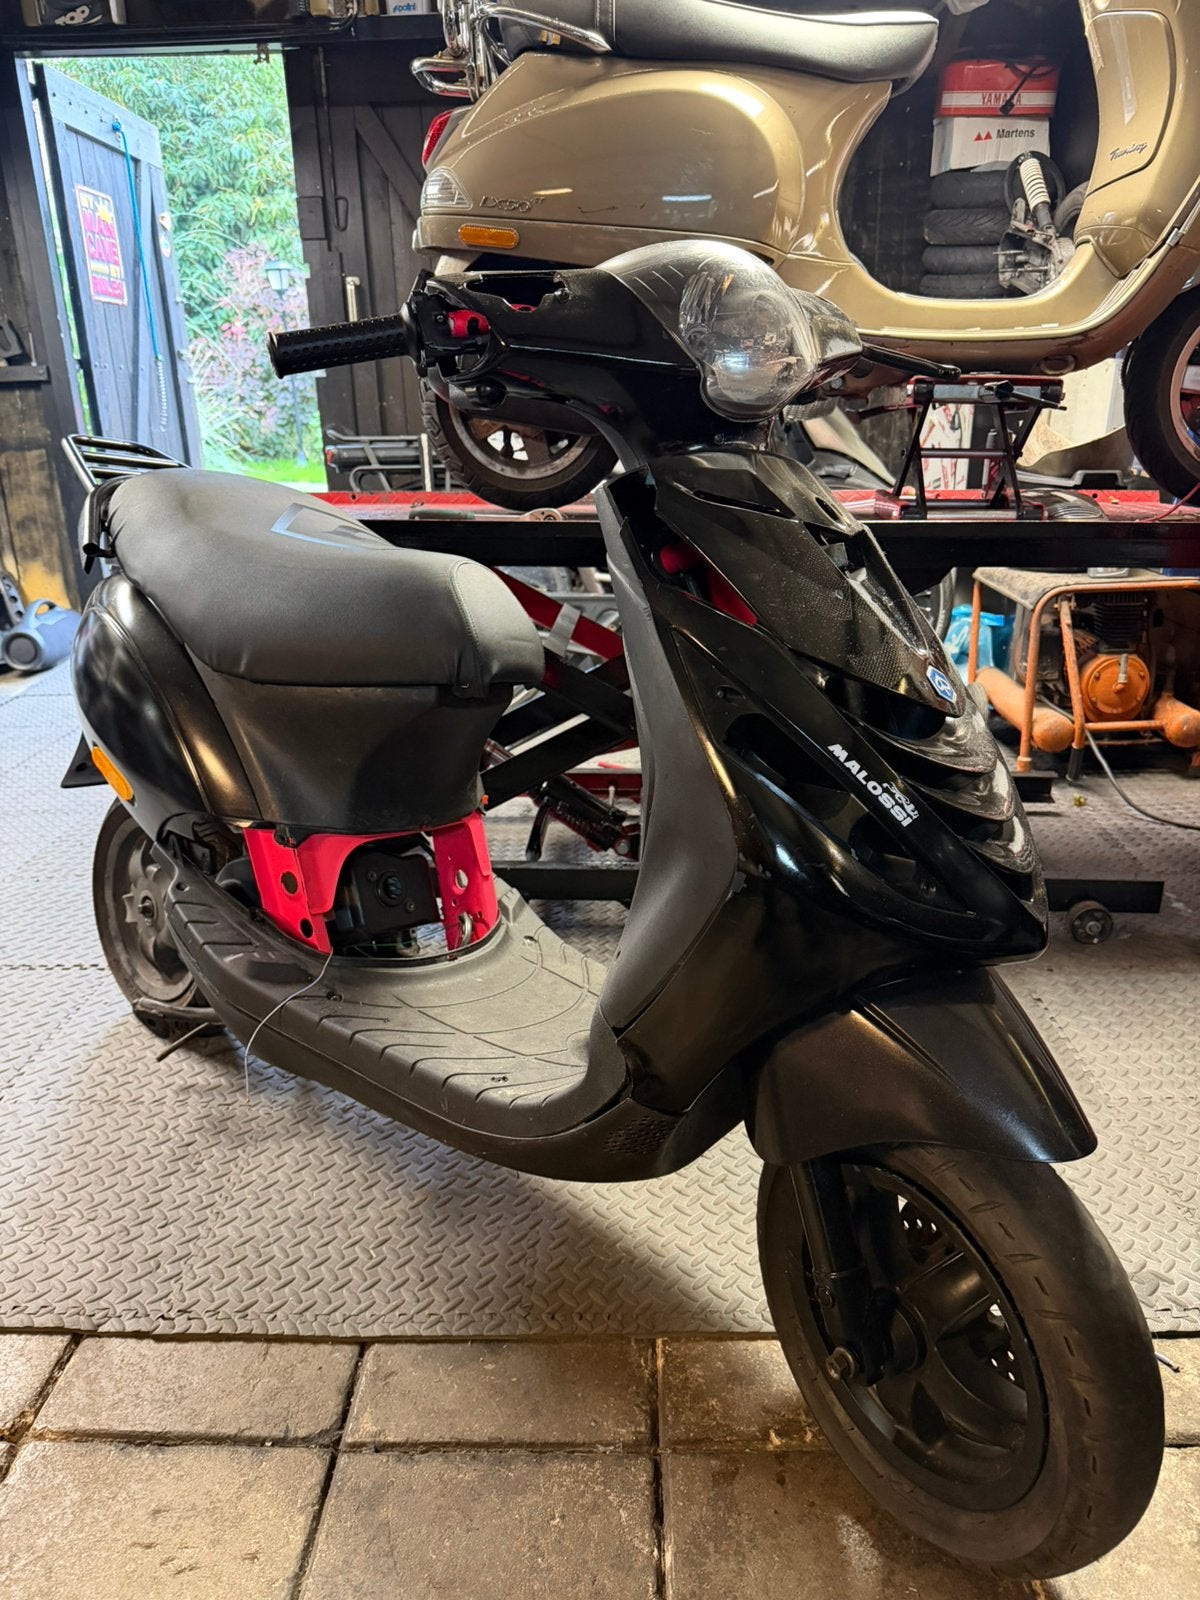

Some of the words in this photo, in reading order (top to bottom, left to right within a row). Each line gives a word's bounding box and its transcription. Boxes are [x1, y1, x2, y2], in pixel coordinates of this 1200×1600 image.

[981, 92, 1022, 106] YAMAA
[996, 128, 1036, 139] Martens
[86, 231, 120, 267] CAVE
[827, 743, 913, 827] MALOSSI
